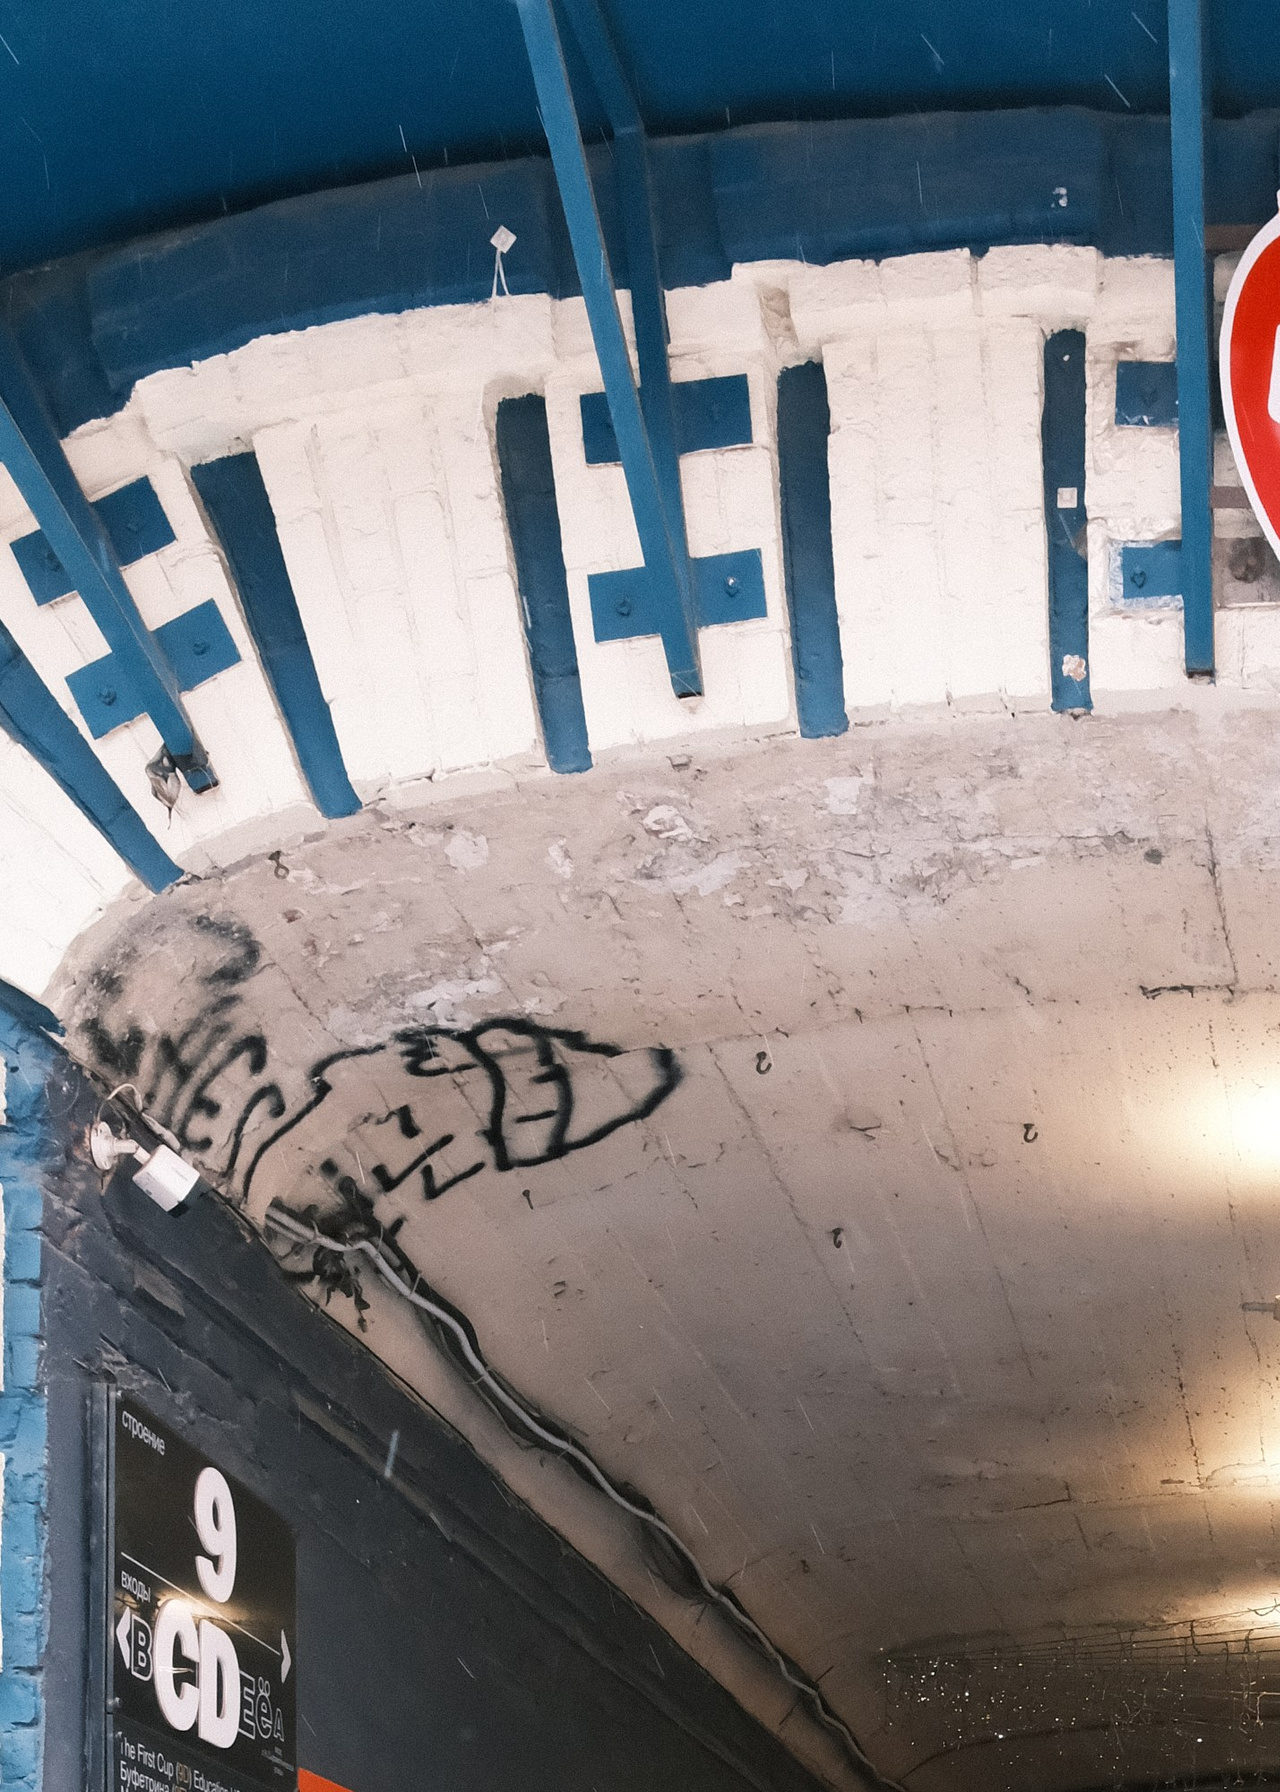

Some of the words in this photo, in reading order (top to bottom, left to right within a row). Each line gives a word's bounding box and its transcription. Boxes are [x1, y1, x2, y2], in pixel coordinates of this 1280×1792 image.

[122, 1410, 165, 1455] строение
[194, 1467, 237, 1602] 9
[121, 1571, 151, 1602] входы
[137, 1743, 156, 1769] First
[157, 1753, 174, 1780] Cup
